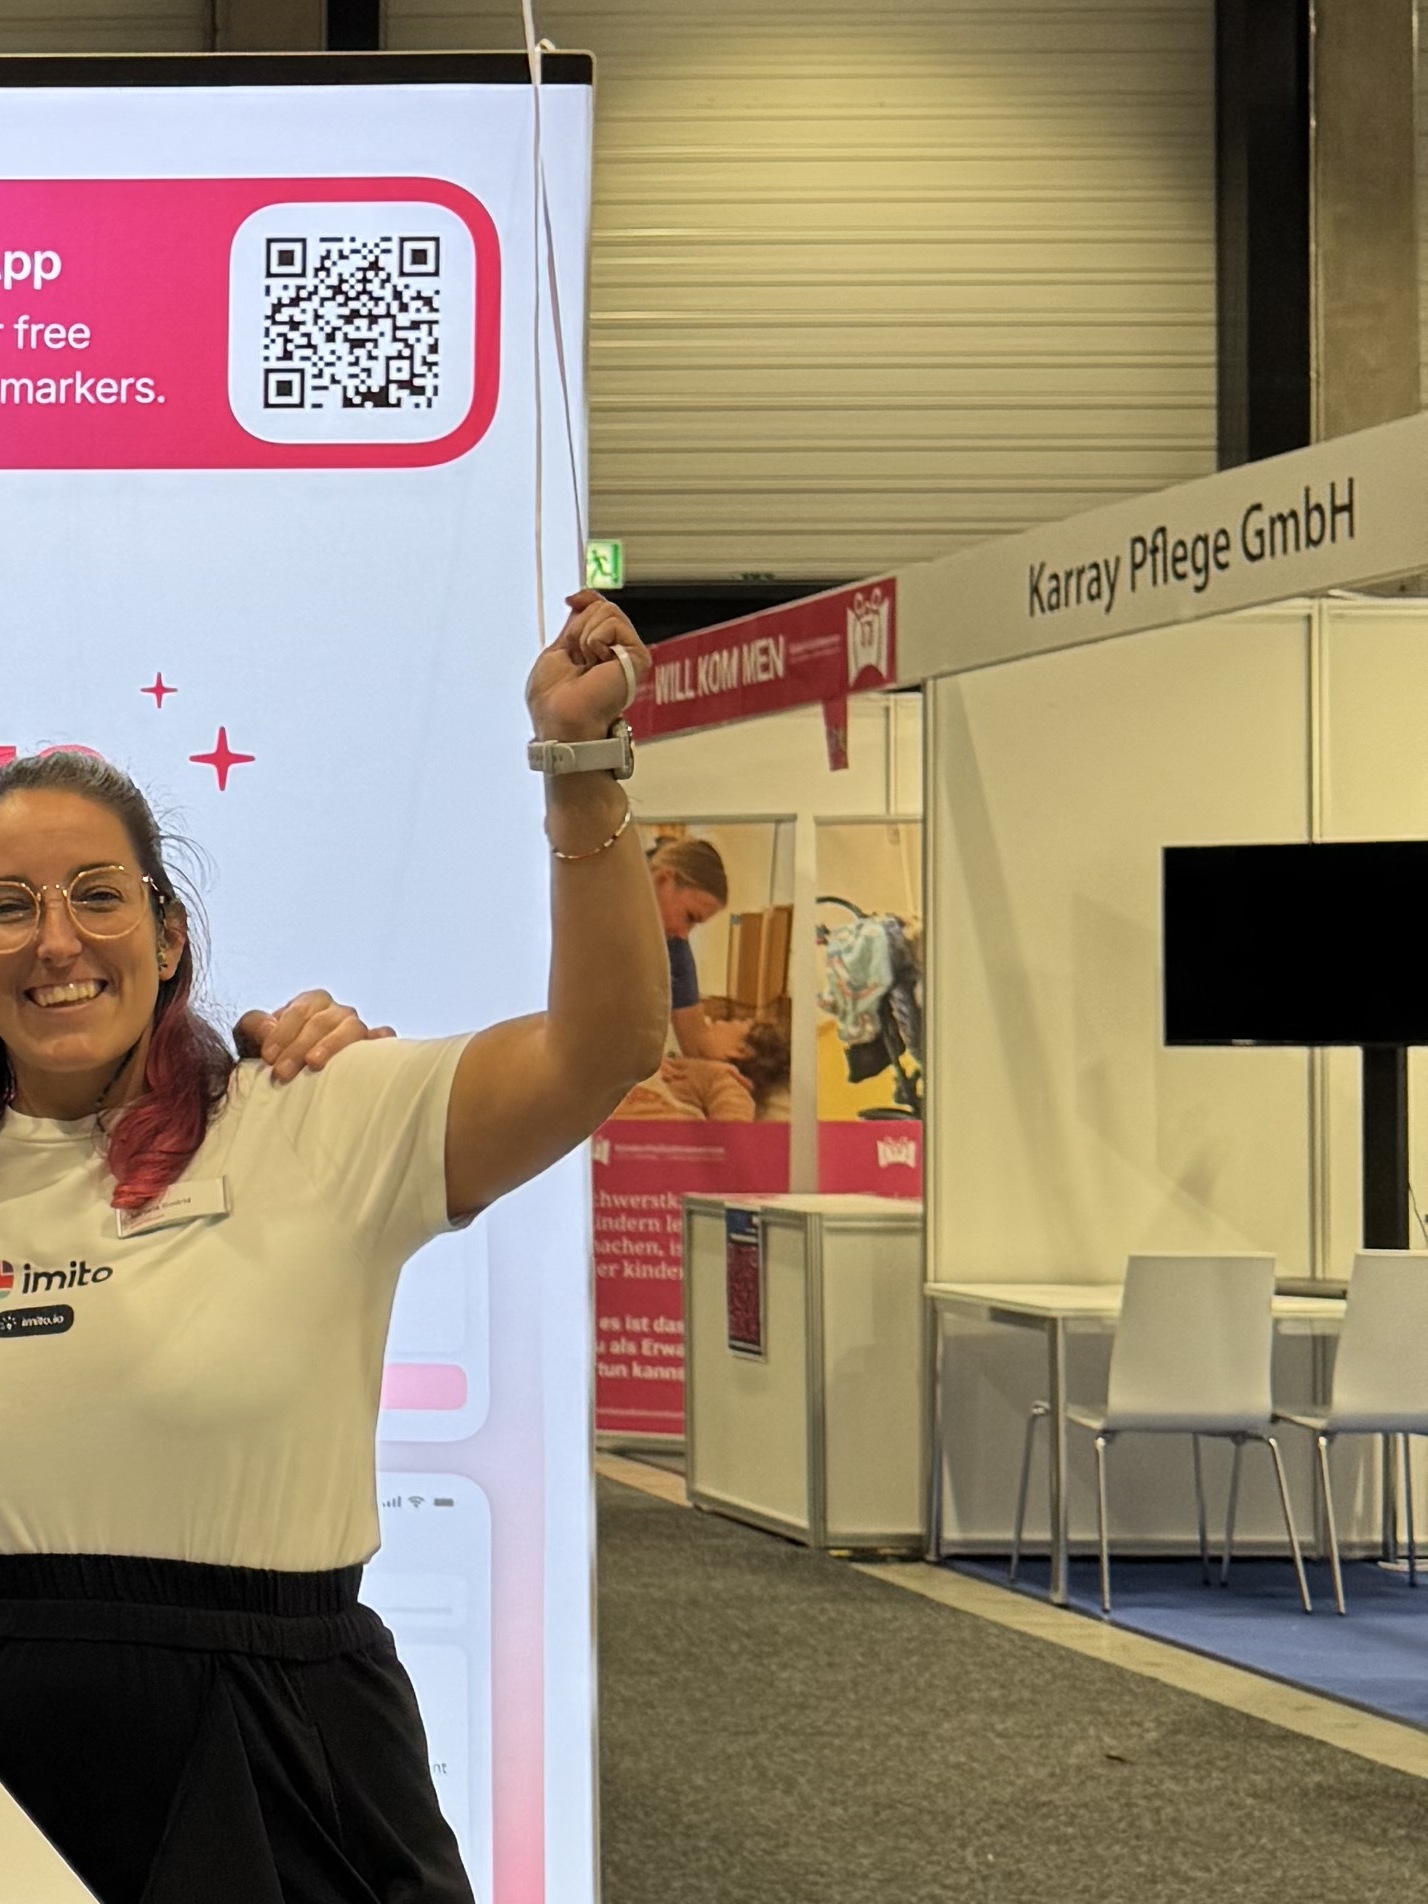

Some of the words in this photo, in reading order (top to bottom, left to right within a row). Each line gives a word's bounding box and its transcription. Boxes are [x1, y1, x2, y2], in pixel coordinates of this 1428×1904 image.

[14, 315, 90, 349] free
[1, 371, 164, 403] markers.
[1030, 556, 1120, 617] Karray
[1131, 526, 1230, 593] Pflege
[1242, 478, 1354, 562] GmbH
[23, 1261, 113, 1293] imito
